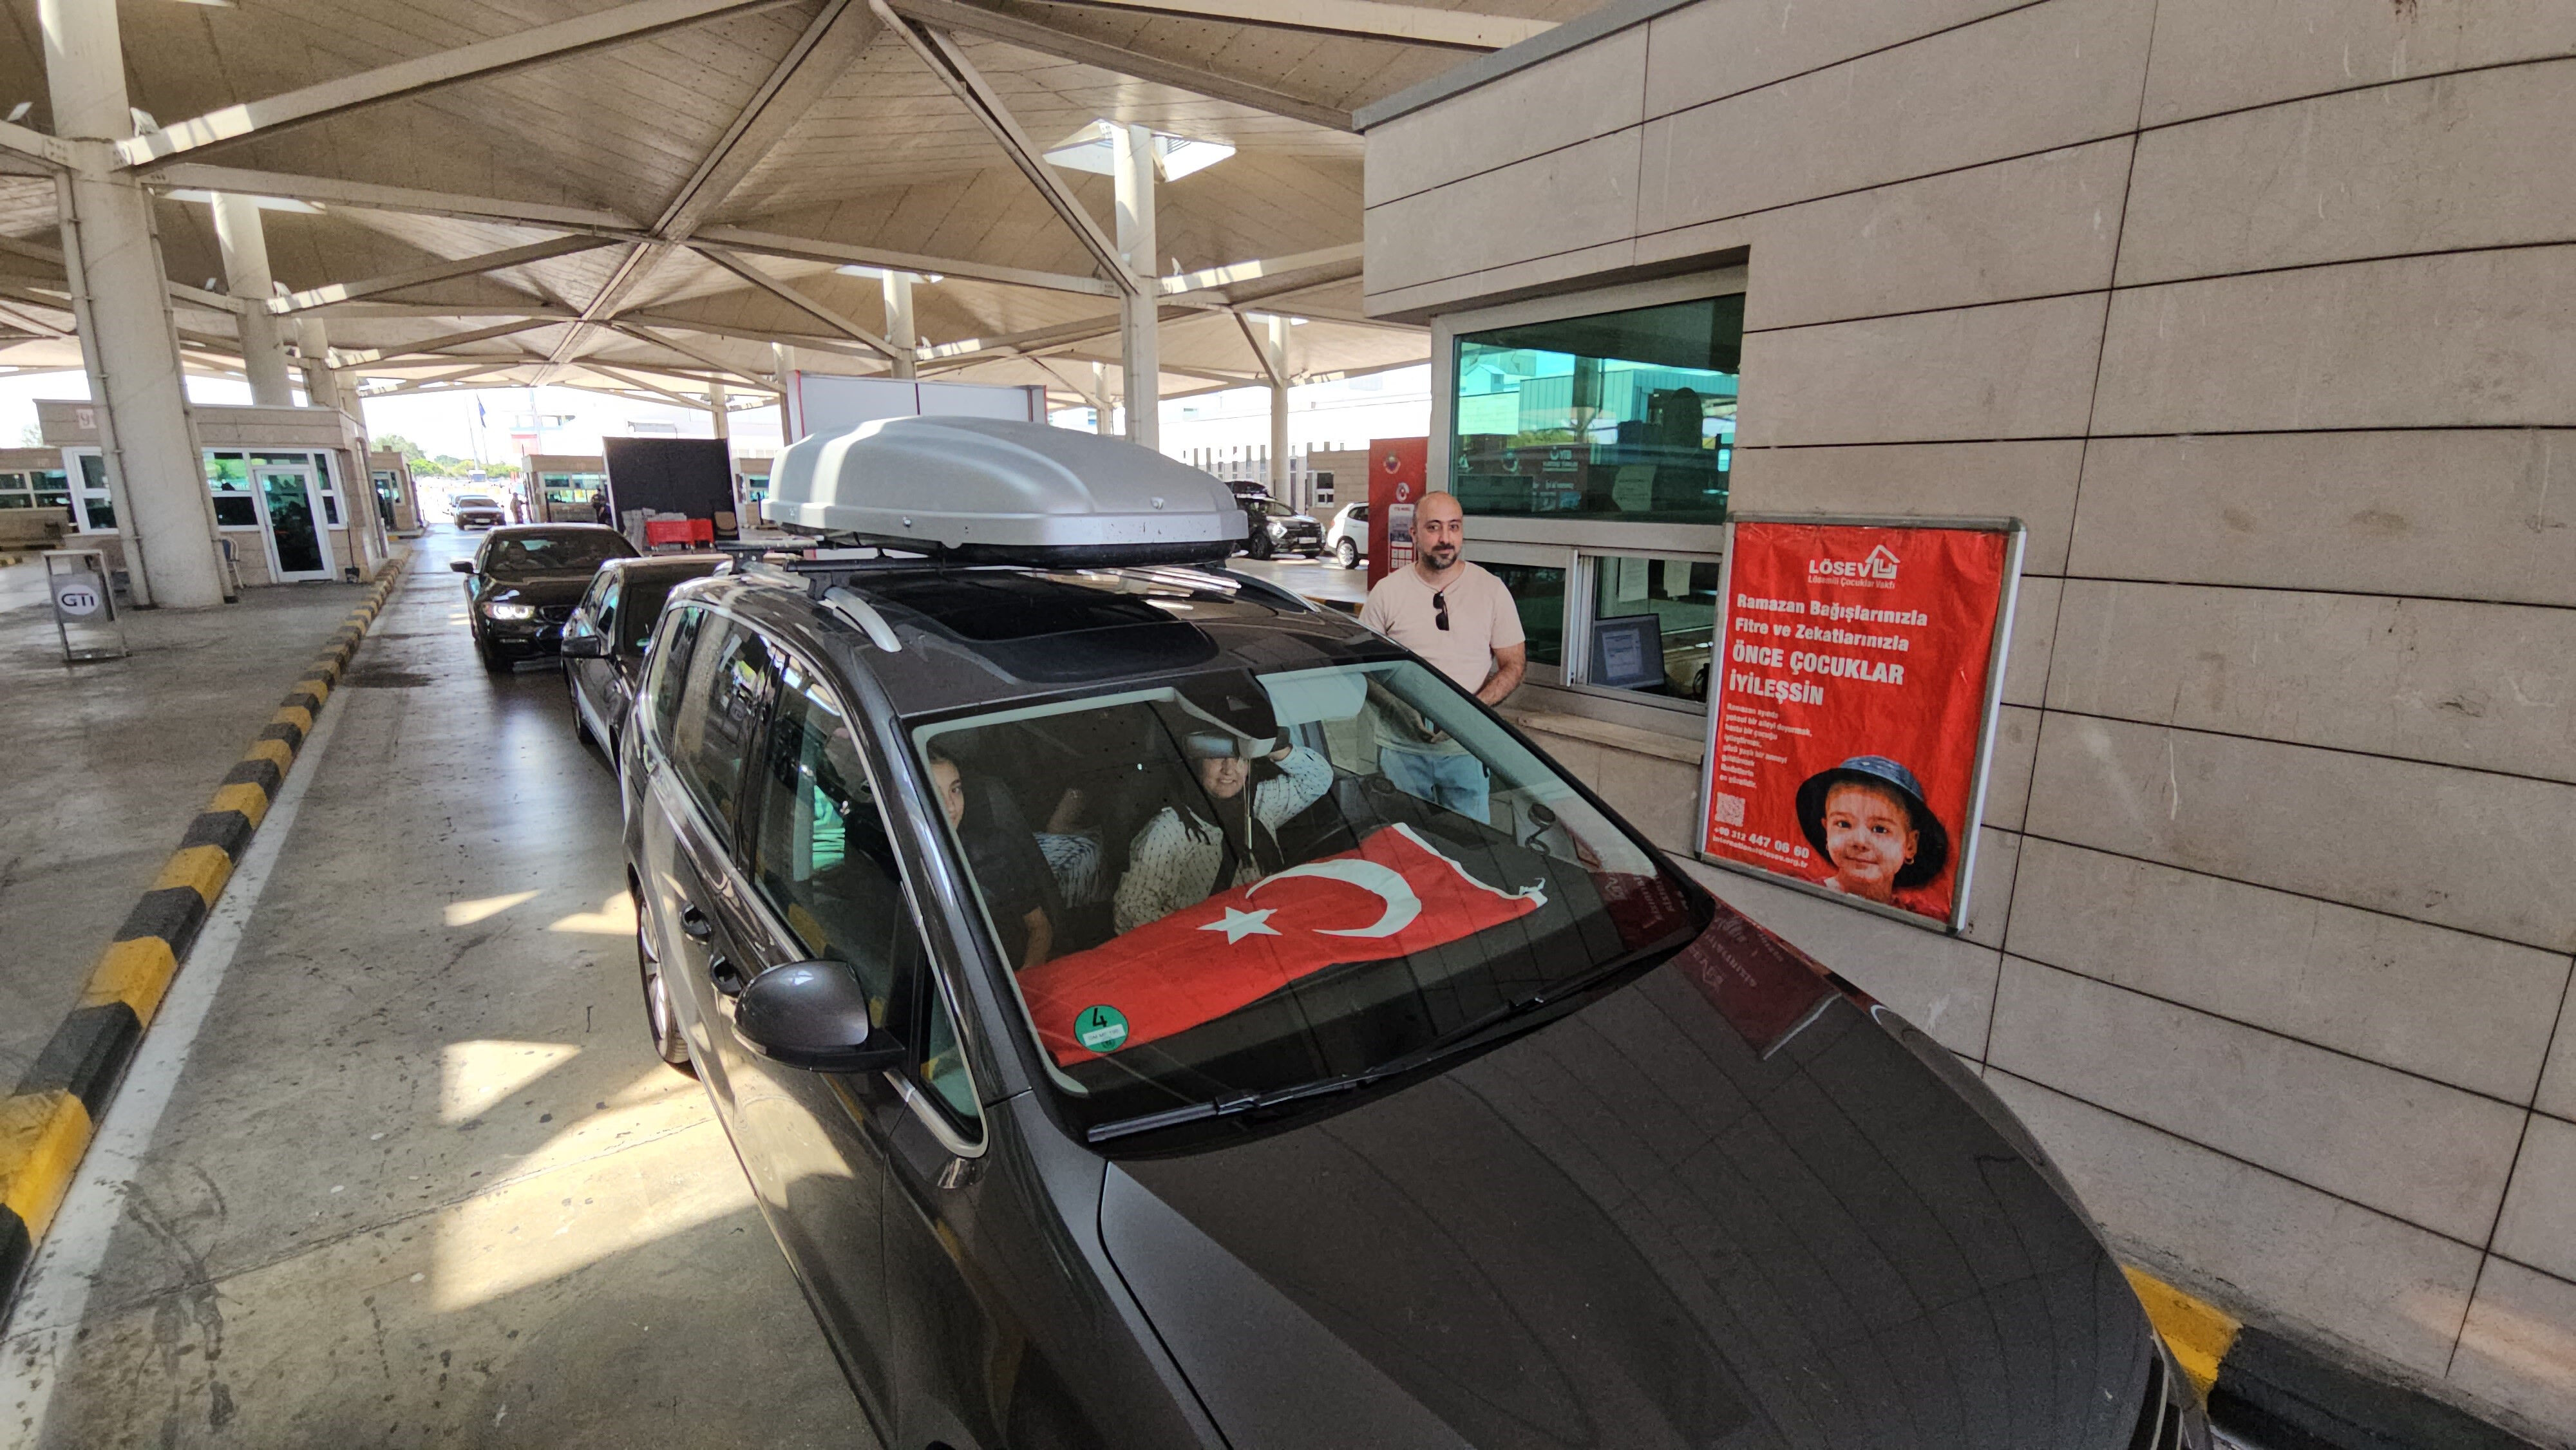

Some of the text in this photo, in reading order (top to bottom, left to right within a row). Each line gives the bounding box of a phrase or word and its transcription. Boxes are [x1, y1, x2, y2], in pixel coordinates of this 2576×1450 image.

[1809, 558, 1871, 577] LÖSEV
[1841, 577, 1875, 587] Çocuklar
[1737, 593, 1927, 626] Ramazan Bağışlarınızla
[1735, 617, 1909, 652] Fitre ve Zekatlarınızla
[1732, 639, 1905, 686] ÖNCE ÇOCUKLAR
[1729, 668, 1824, 706] İYİLEŞSİN
[1731, 830, 1747, 842] 312
[1748, 833, 1771, 847] 447
[1774, 840, 1790, 853] 06
[1794, 845, 1810, 858] 60
[1093, 1008, 1108, 1027] 4
